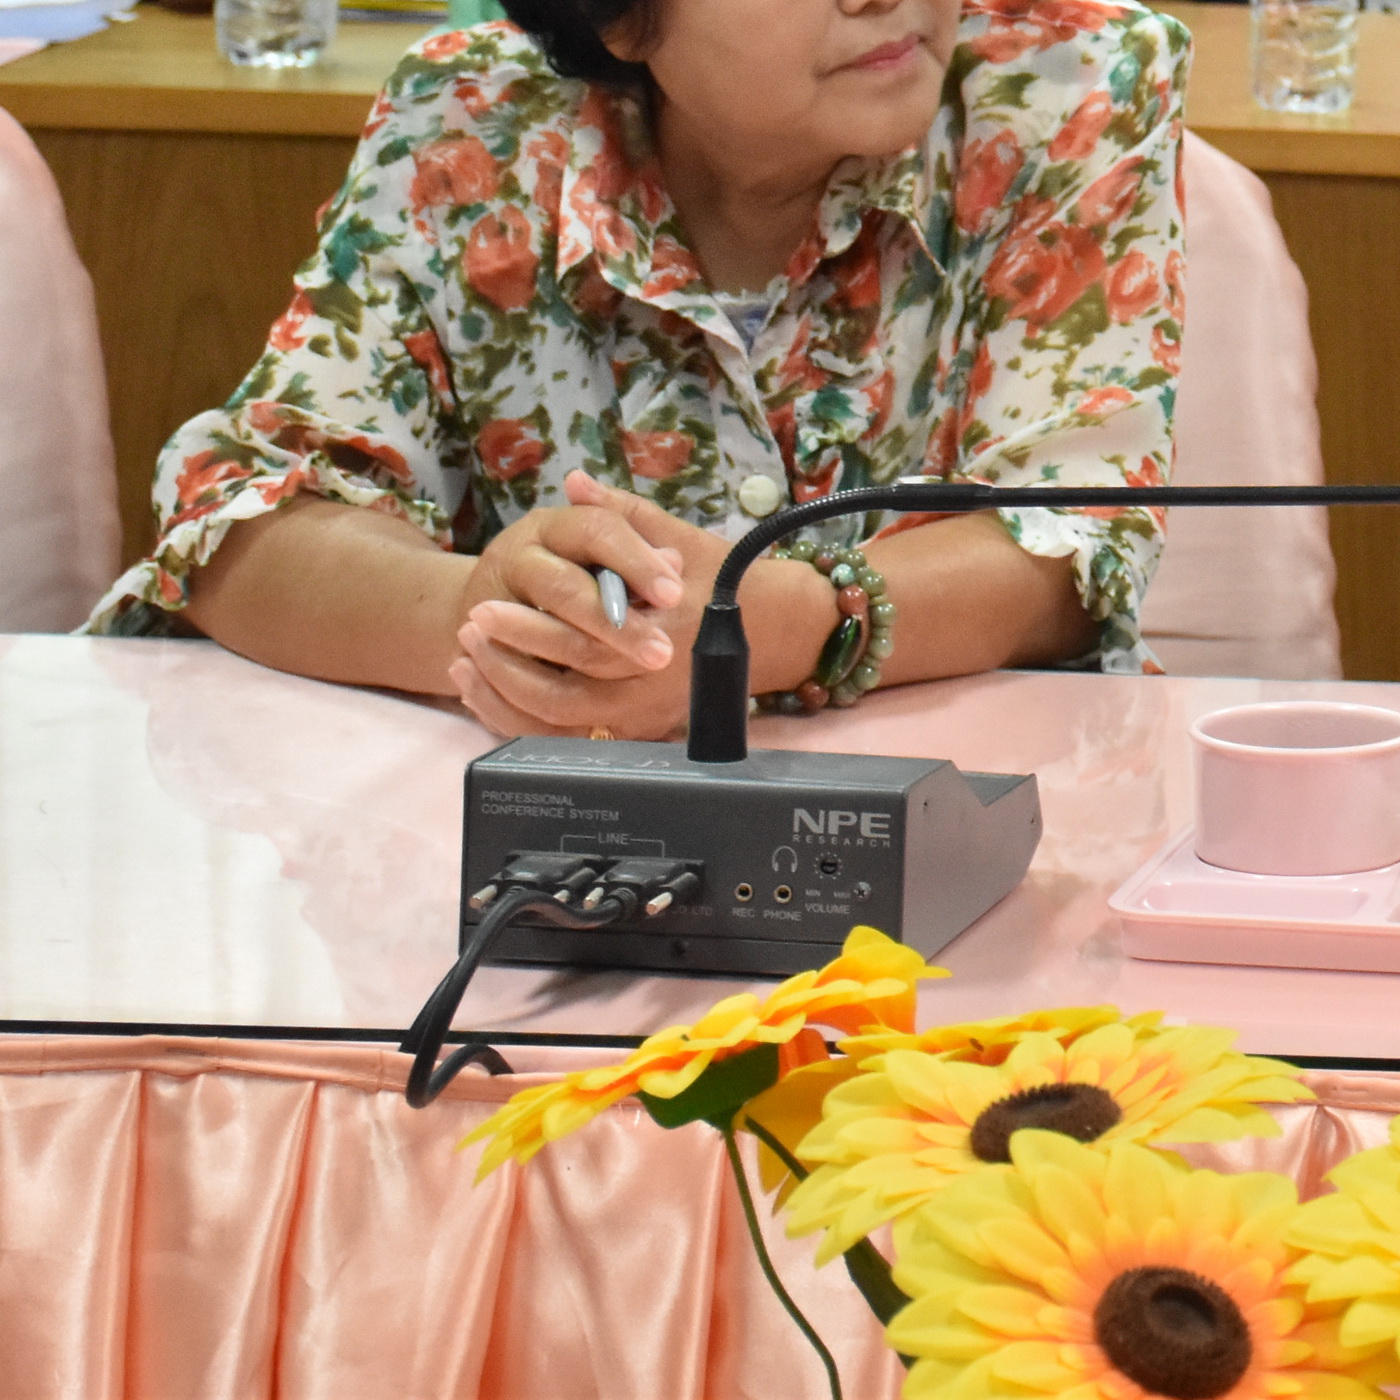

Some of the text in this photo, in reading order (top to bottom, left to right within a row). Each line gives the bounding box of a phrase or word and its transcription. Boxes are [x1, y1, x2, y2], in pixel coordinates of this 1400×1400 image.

[481, 789, 575, 807] PROFESSIONAL
[481, 803, 620, 822] CONFERENCE SYSTEM
[792, 808, 892, 839] NPE
[598, 832, 630, 846] LINE
[792, 834, 891, 849] RESEARCH
[731, 907, 755, 918] REC
[763, 909, 802, 922] PHONE
[805, 903, 850, 915] VOLUME
